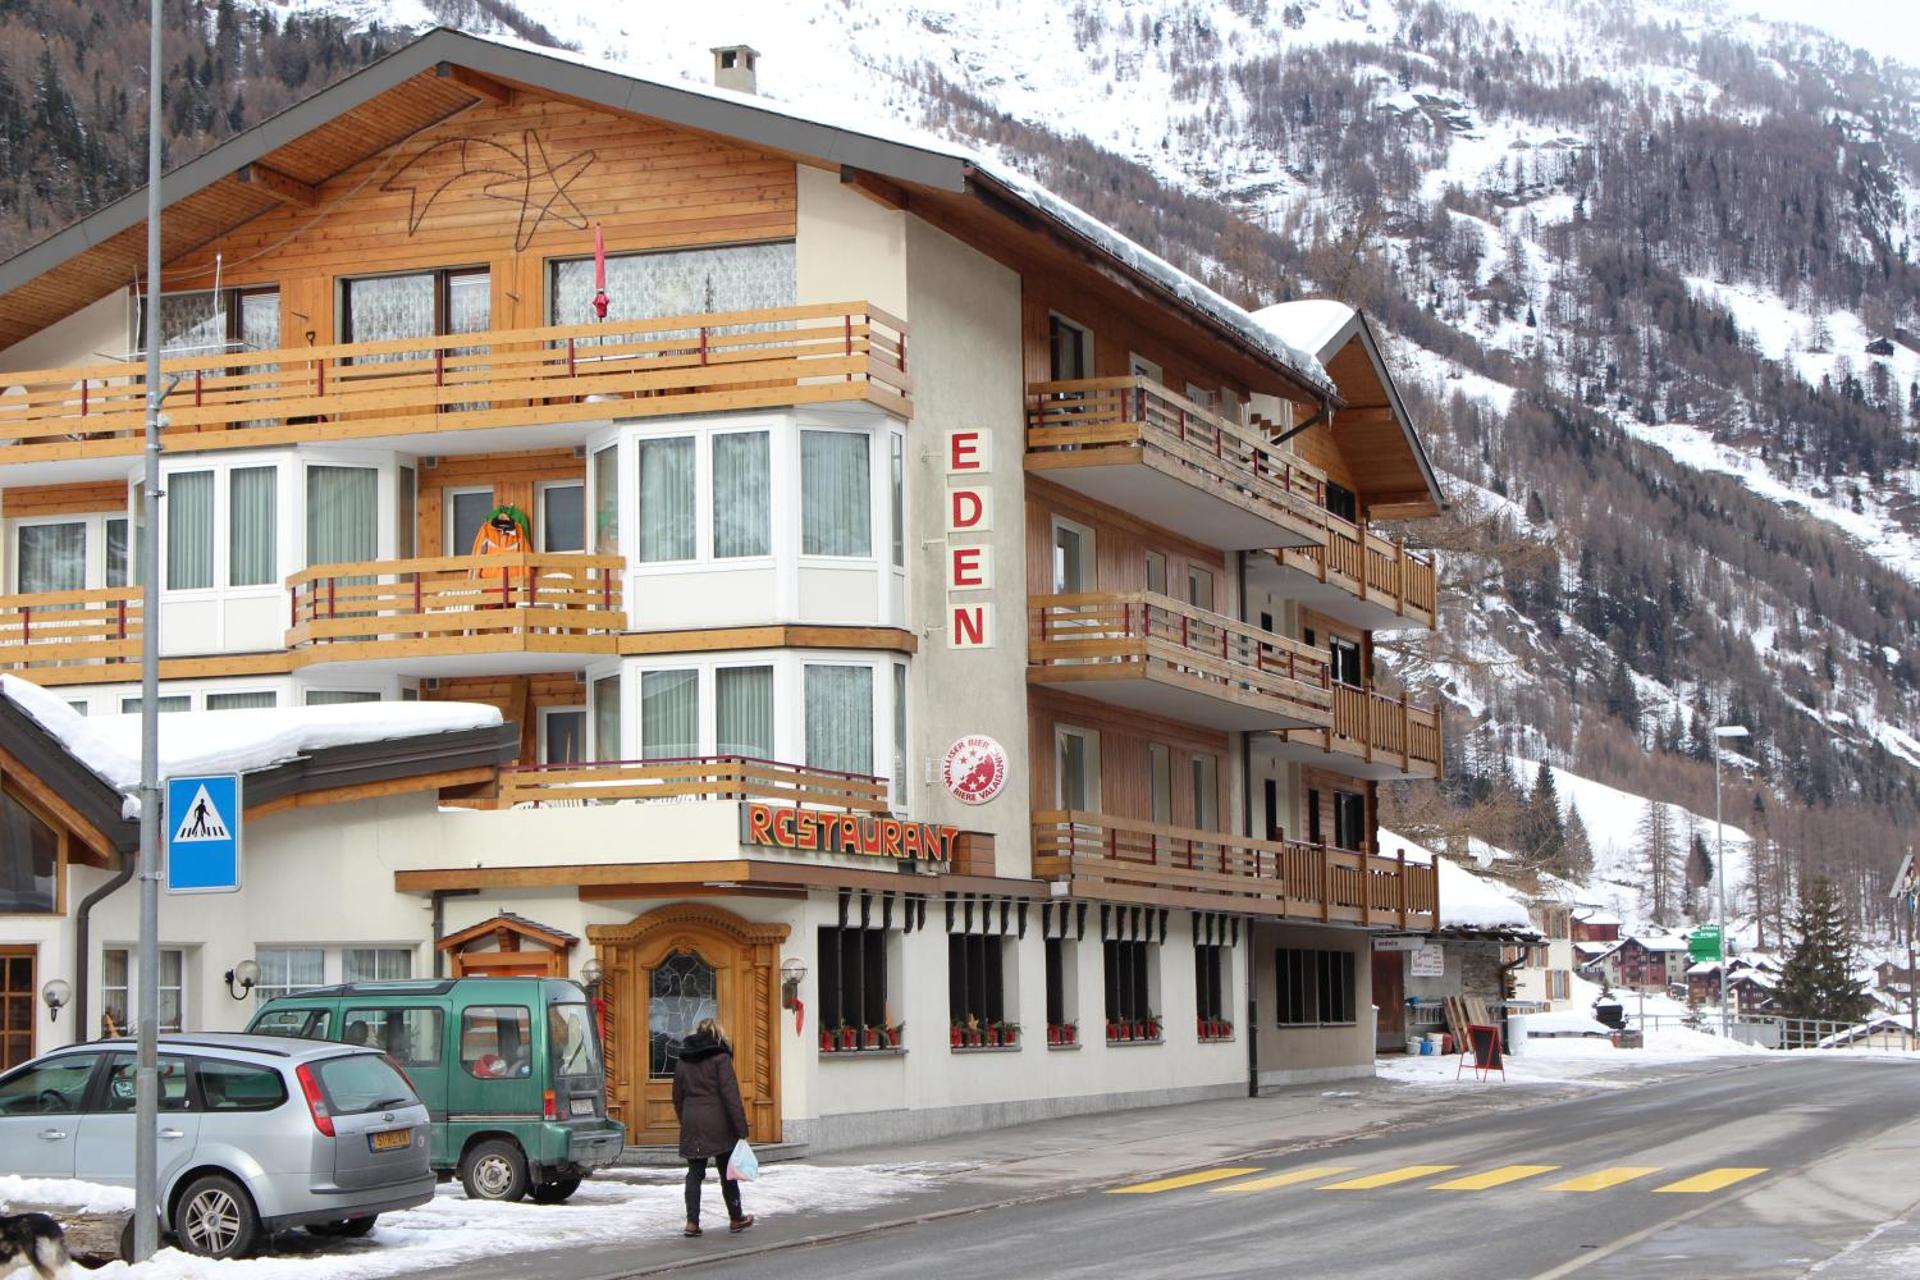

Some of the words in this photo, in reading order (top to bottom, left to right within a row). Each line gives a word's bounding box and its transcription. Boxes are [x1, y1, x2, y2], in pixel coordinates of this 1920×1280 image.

[951, 432, 984, 645] EDEN
[944, 741, 966, 788] WALLISER
[953, 787, 976, 801] BIERE
[749, 803, 959, 863] RESTAURANT
